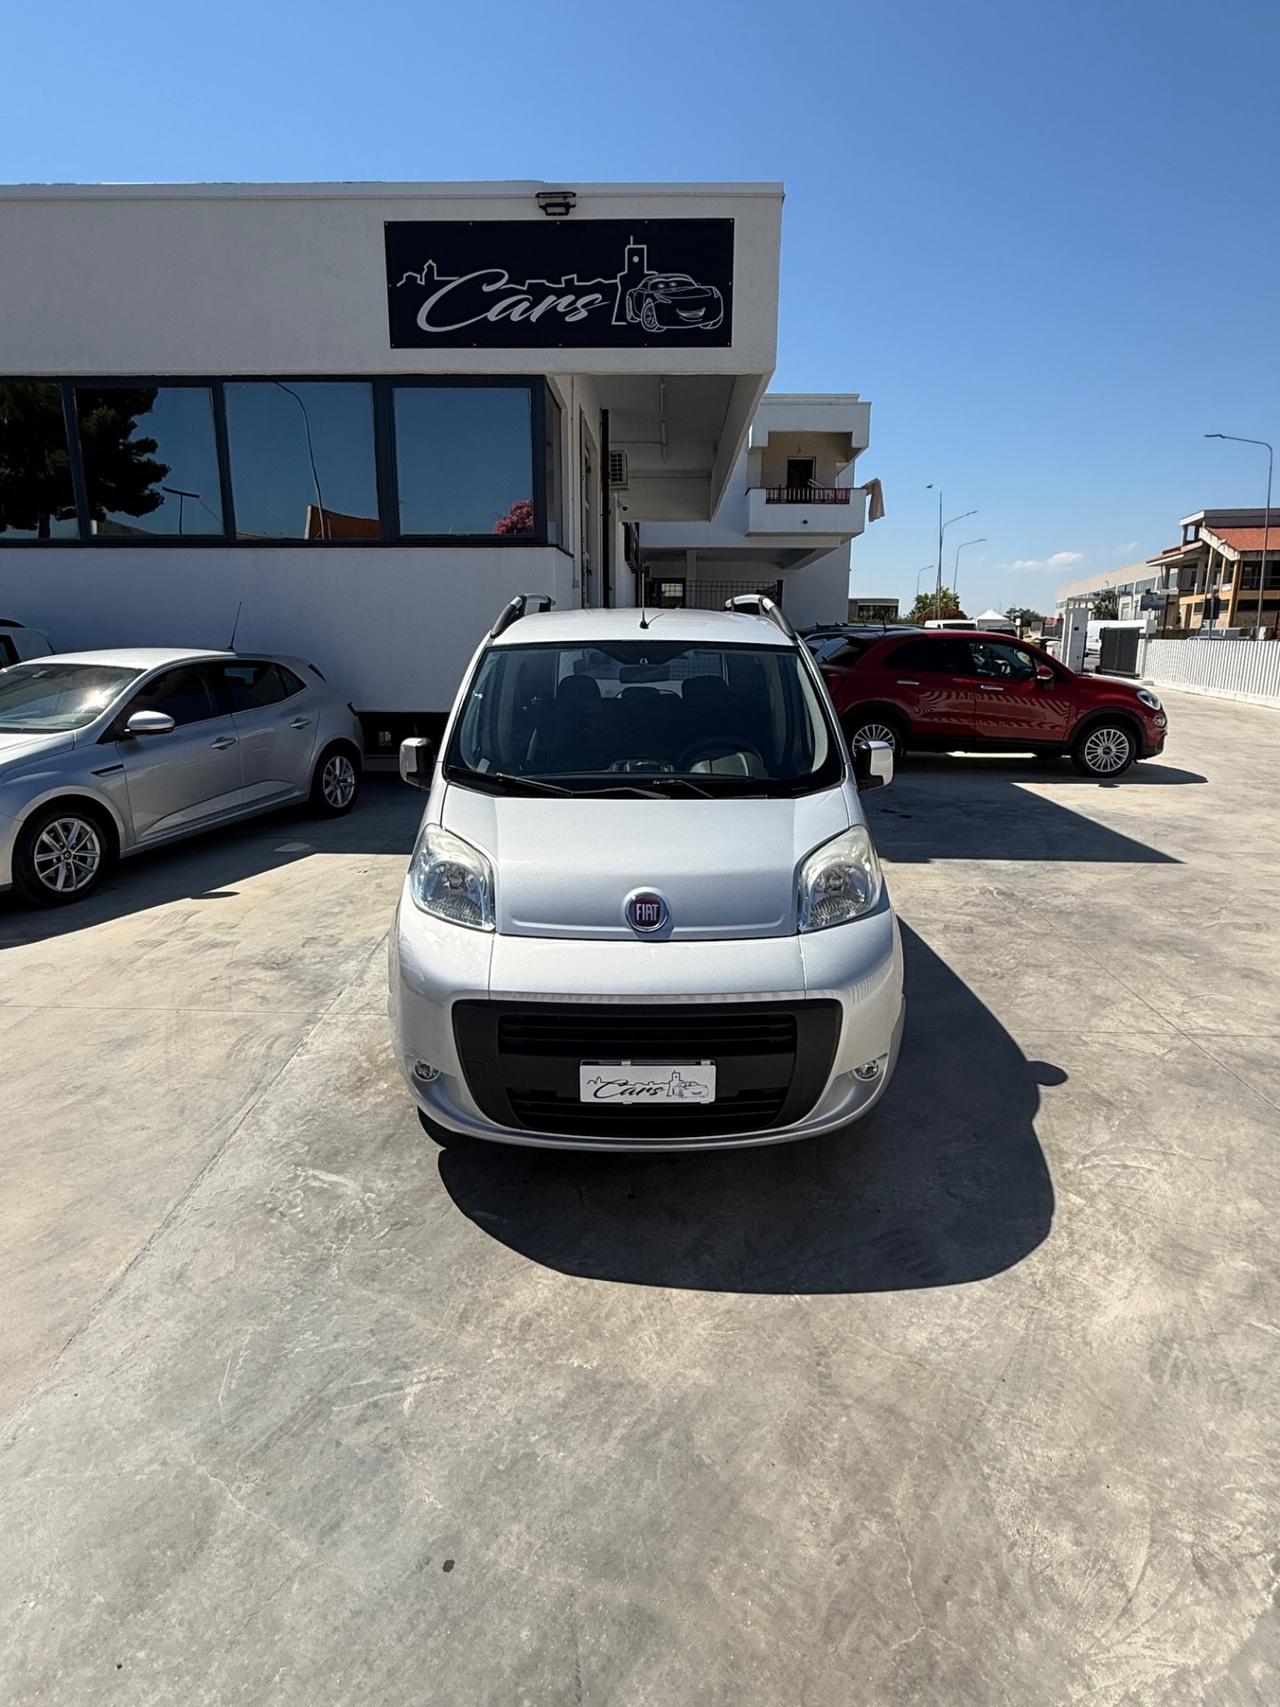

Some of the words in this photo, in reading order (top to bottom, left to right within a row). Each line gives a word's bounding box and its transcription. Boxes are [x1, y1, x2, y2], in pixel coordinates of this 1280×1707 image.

[417, 269, 610, 332] Cars
[636, 904, 659, 921] FIAT
[593, 1078, 664, 1099] Cars
